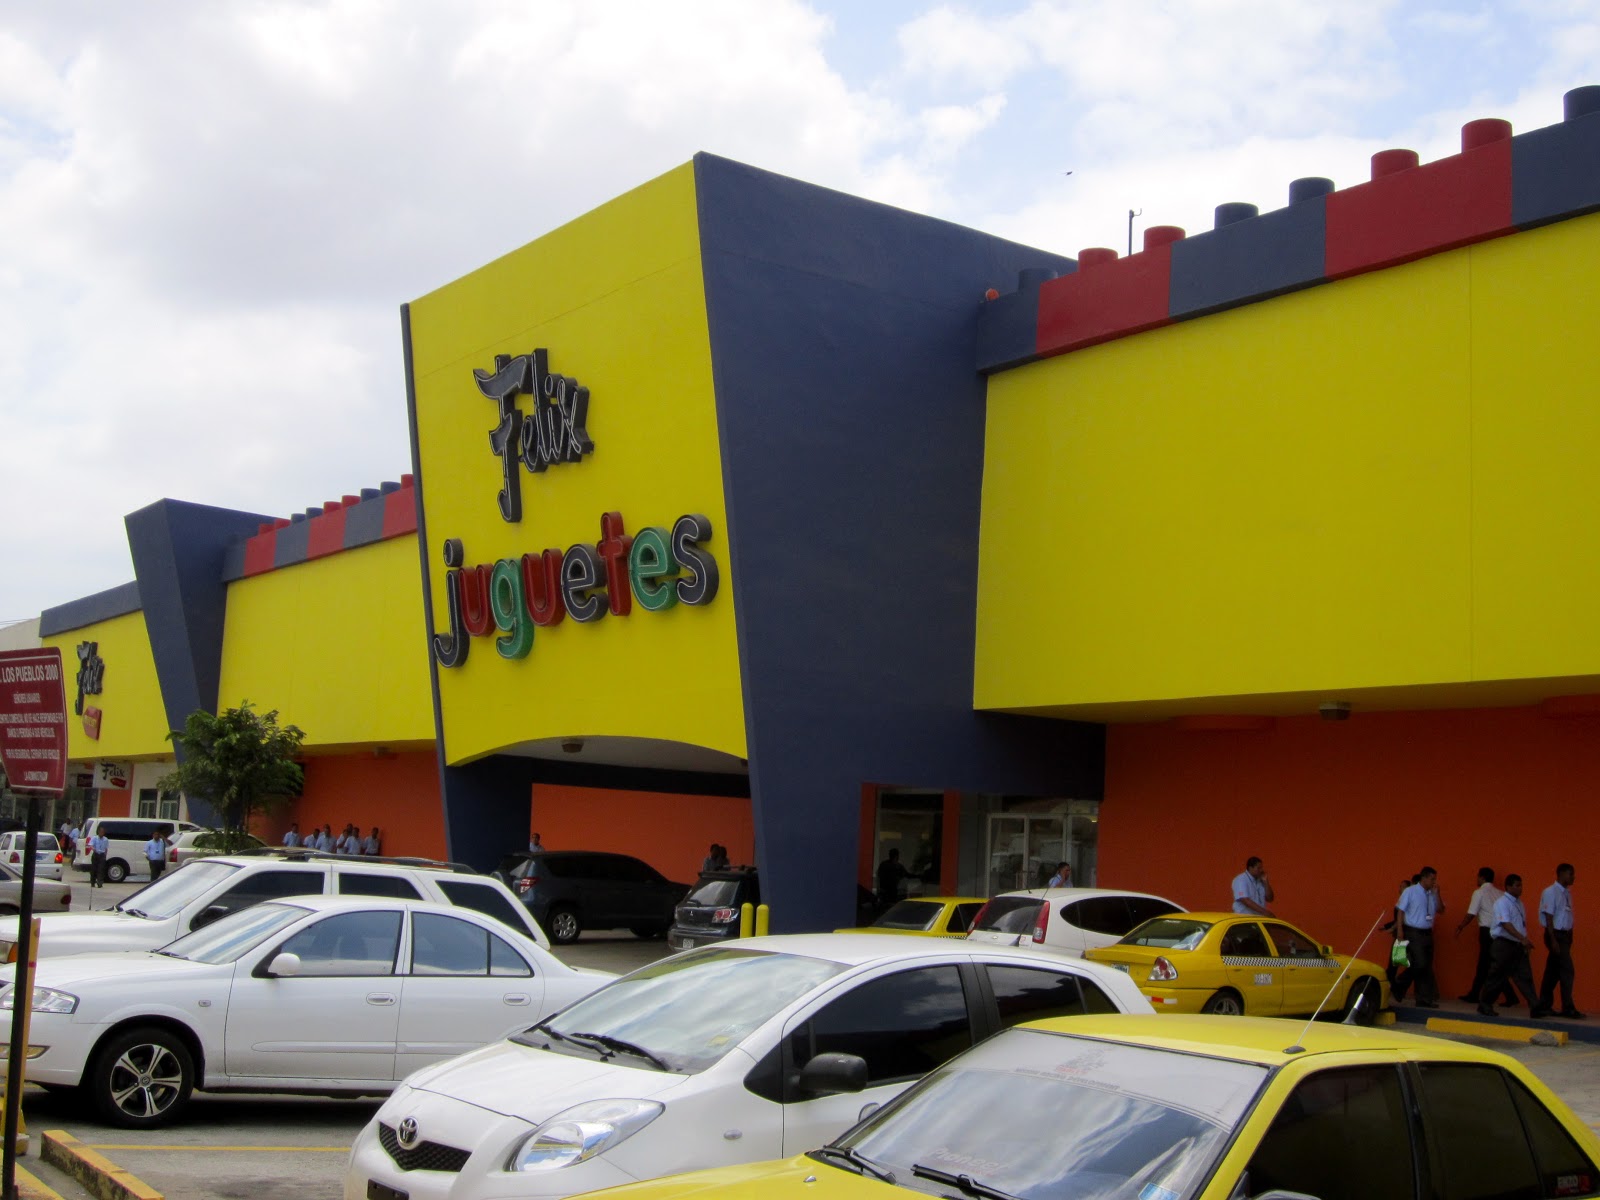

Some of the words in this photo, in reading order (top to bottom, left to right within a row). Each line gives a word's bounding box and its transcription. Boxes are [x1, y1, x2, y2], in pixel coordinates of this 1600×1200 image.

[473, 348, 595, 523] Felix
[434, 511, 719, 668] juguetes
[1, 666, 16, 683] LOS
[15, 665, 45, 682] PUEBLOS
[45, 664, 59, 681] 2000
[100, 762, 125, 781] Felix
[927, 1147, 1010, 1171] Pioneer
